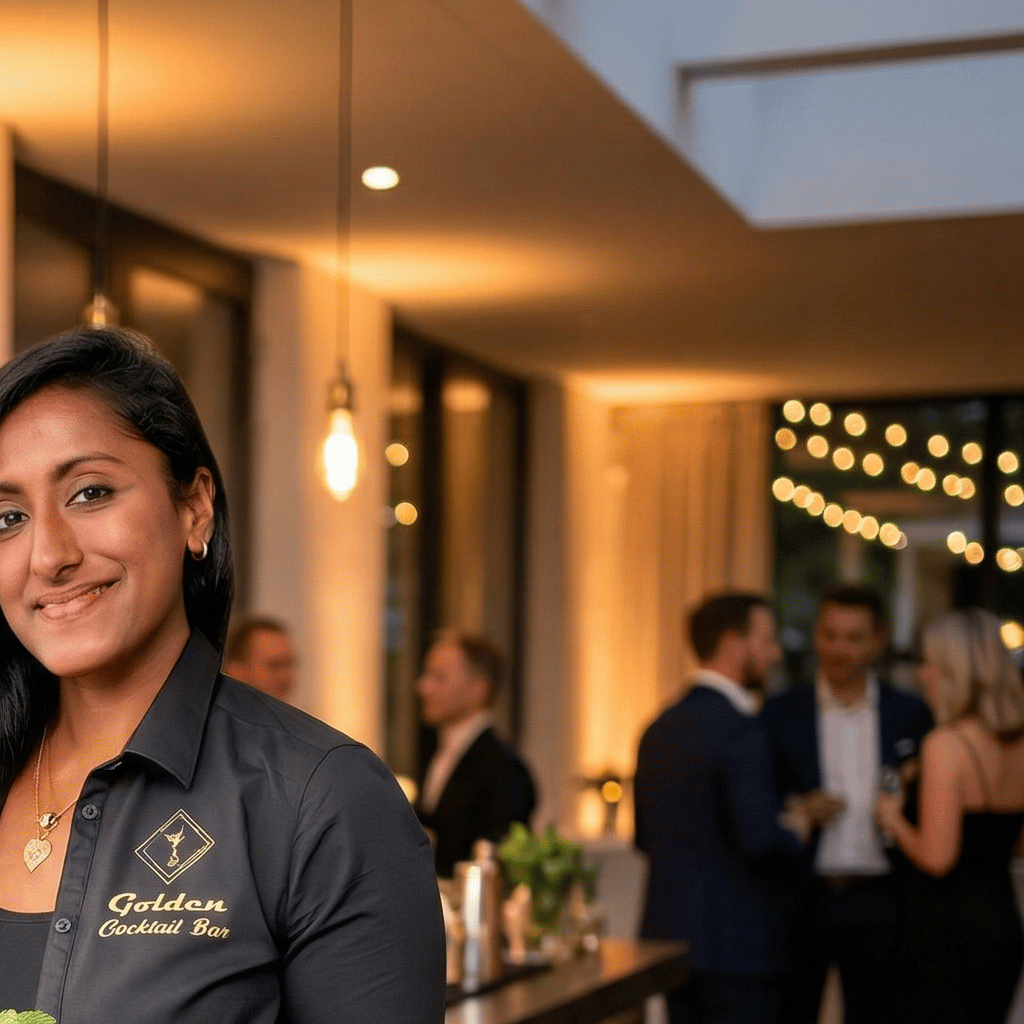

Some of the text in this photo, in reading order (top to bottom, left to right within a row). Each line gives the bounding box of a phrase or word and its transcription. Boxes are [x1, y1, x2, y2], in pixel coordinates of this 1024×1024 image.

[108, 892, 228, 917] Golden
[98, 917, 230, 939] Cocktail Bar
